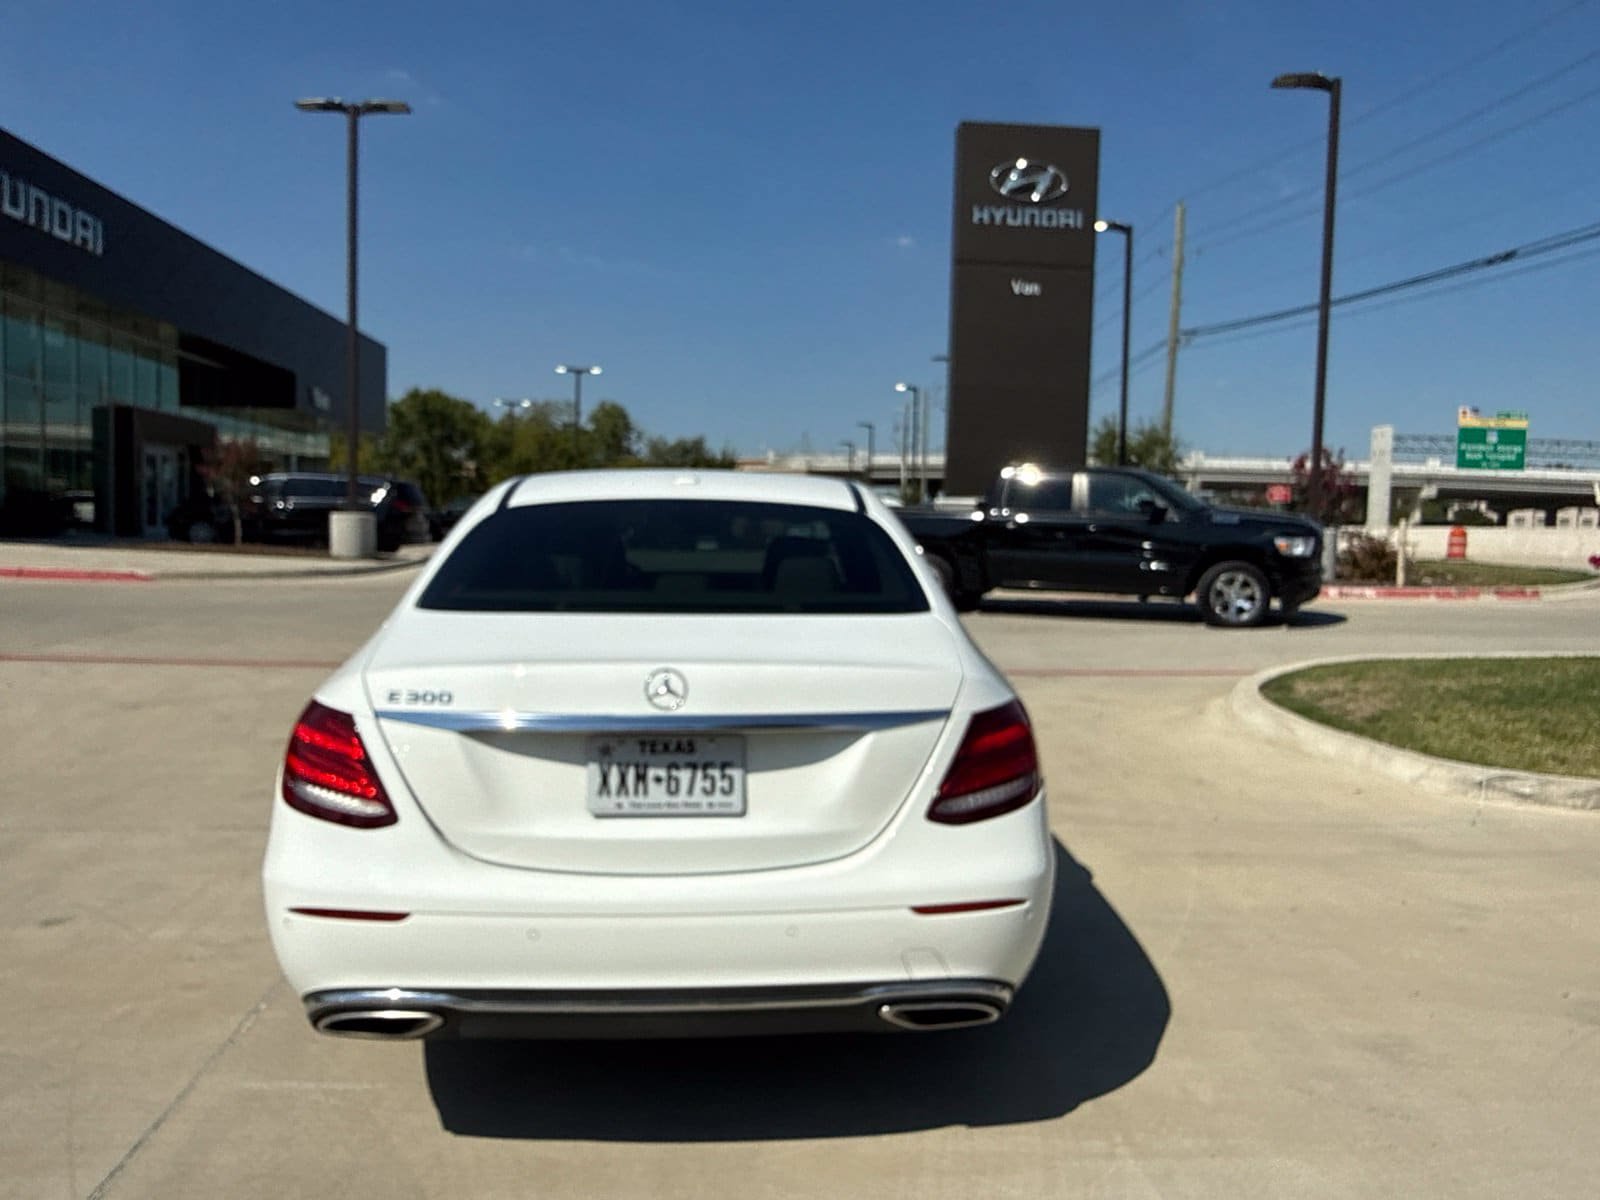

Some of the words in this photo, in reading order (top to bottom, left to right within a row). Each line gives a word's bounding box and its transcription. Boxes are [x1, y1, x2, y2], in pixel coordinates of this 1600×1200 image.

[0, 172, 103, 257] UNDAI
[972, 205, 1083, 229] HYUNDAI
[406, 690, 452, 705] 300
[638, 738, 696, 754] TEXAS
